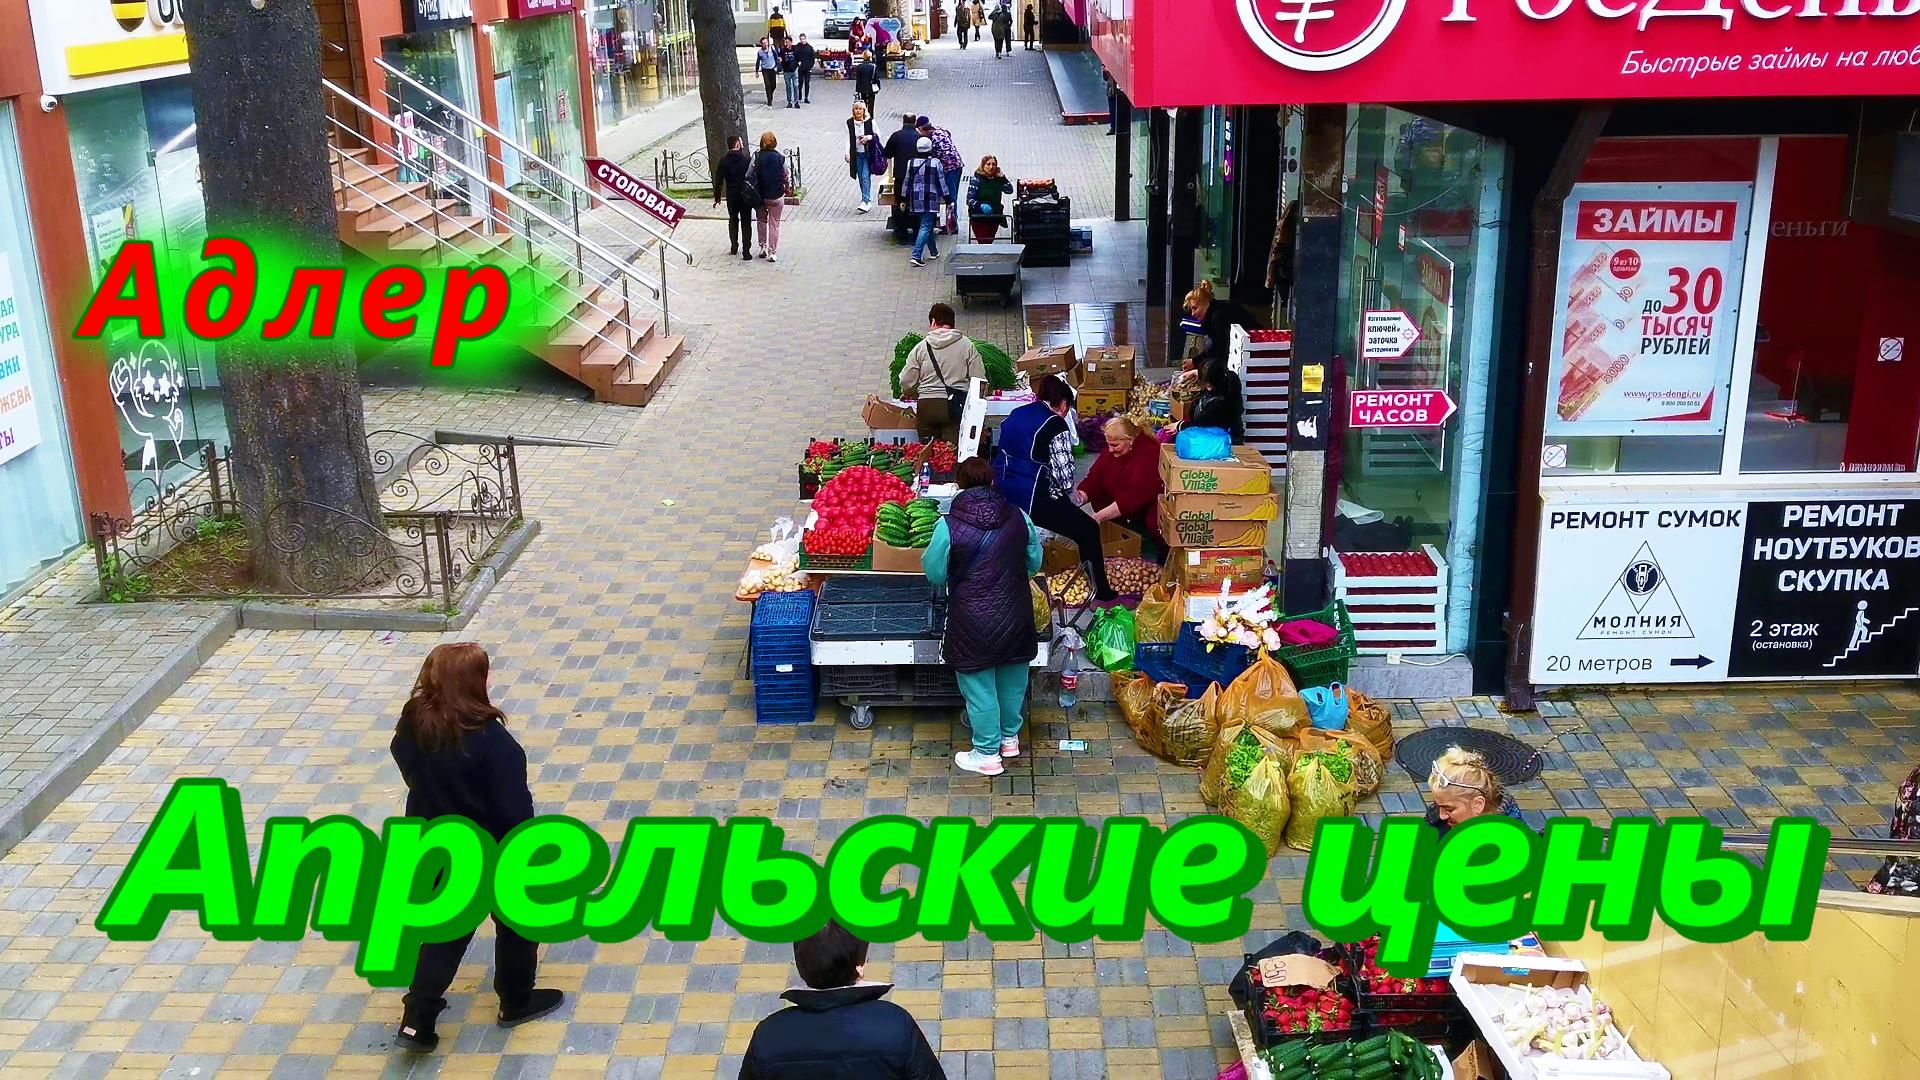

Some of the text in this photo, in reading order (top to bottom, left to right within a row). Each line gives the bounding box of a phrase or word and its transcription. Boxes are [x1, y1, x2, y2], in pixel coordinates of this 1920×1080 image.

[1620, 50, 1742, 79] Быстрые
[1748, 46, 1828, 71] займы
[1836, 50, 1867, 68] на
[597, 164, 677, 221] СТОЛОВАЯ
[1592, 206, 1724, 234] ЗАЙМЫ
[1613, 256, 1620, 266] 9
[1628, 257, 1639, 266] 10
[1661, 266, 1724, 316] 30
[0, 297, 15, 319] АЯ
[1641, 315, 1714, 337] ТЫСЯЧ
[1640, 333, 1712, 355] РУБЛЕЙ
[1355, 393, 1434, 408] РЕМОНТ
[1623, 389, 1702, 399] www.ros-dengi.ru
[1359, 409, 1428, 423] ЧАСОВ
[1179, 469, 1217, 481] Global
[1182, 480, 1218, 492] Village
[1178, 509, 1215, 520] Global
[1549, 509, 1742, 530] РЕМОНТ СУМОК
[1783, 503, 1905, 528] РЕМОНТ
[1175, 521, 1213, 534] Global
[1753, 535, 1920, 561] НОУТБУКОВ
[1777, 568, 1891, 593] СКУПКА
[1593, 615, 1682, 628] МОЛНИЯ
[1750, 620, 1819, 637] 2 этаж
[1752, 639, 1813, 651] (остановка)
[1546, 655, 1653, 673] 20 метров
